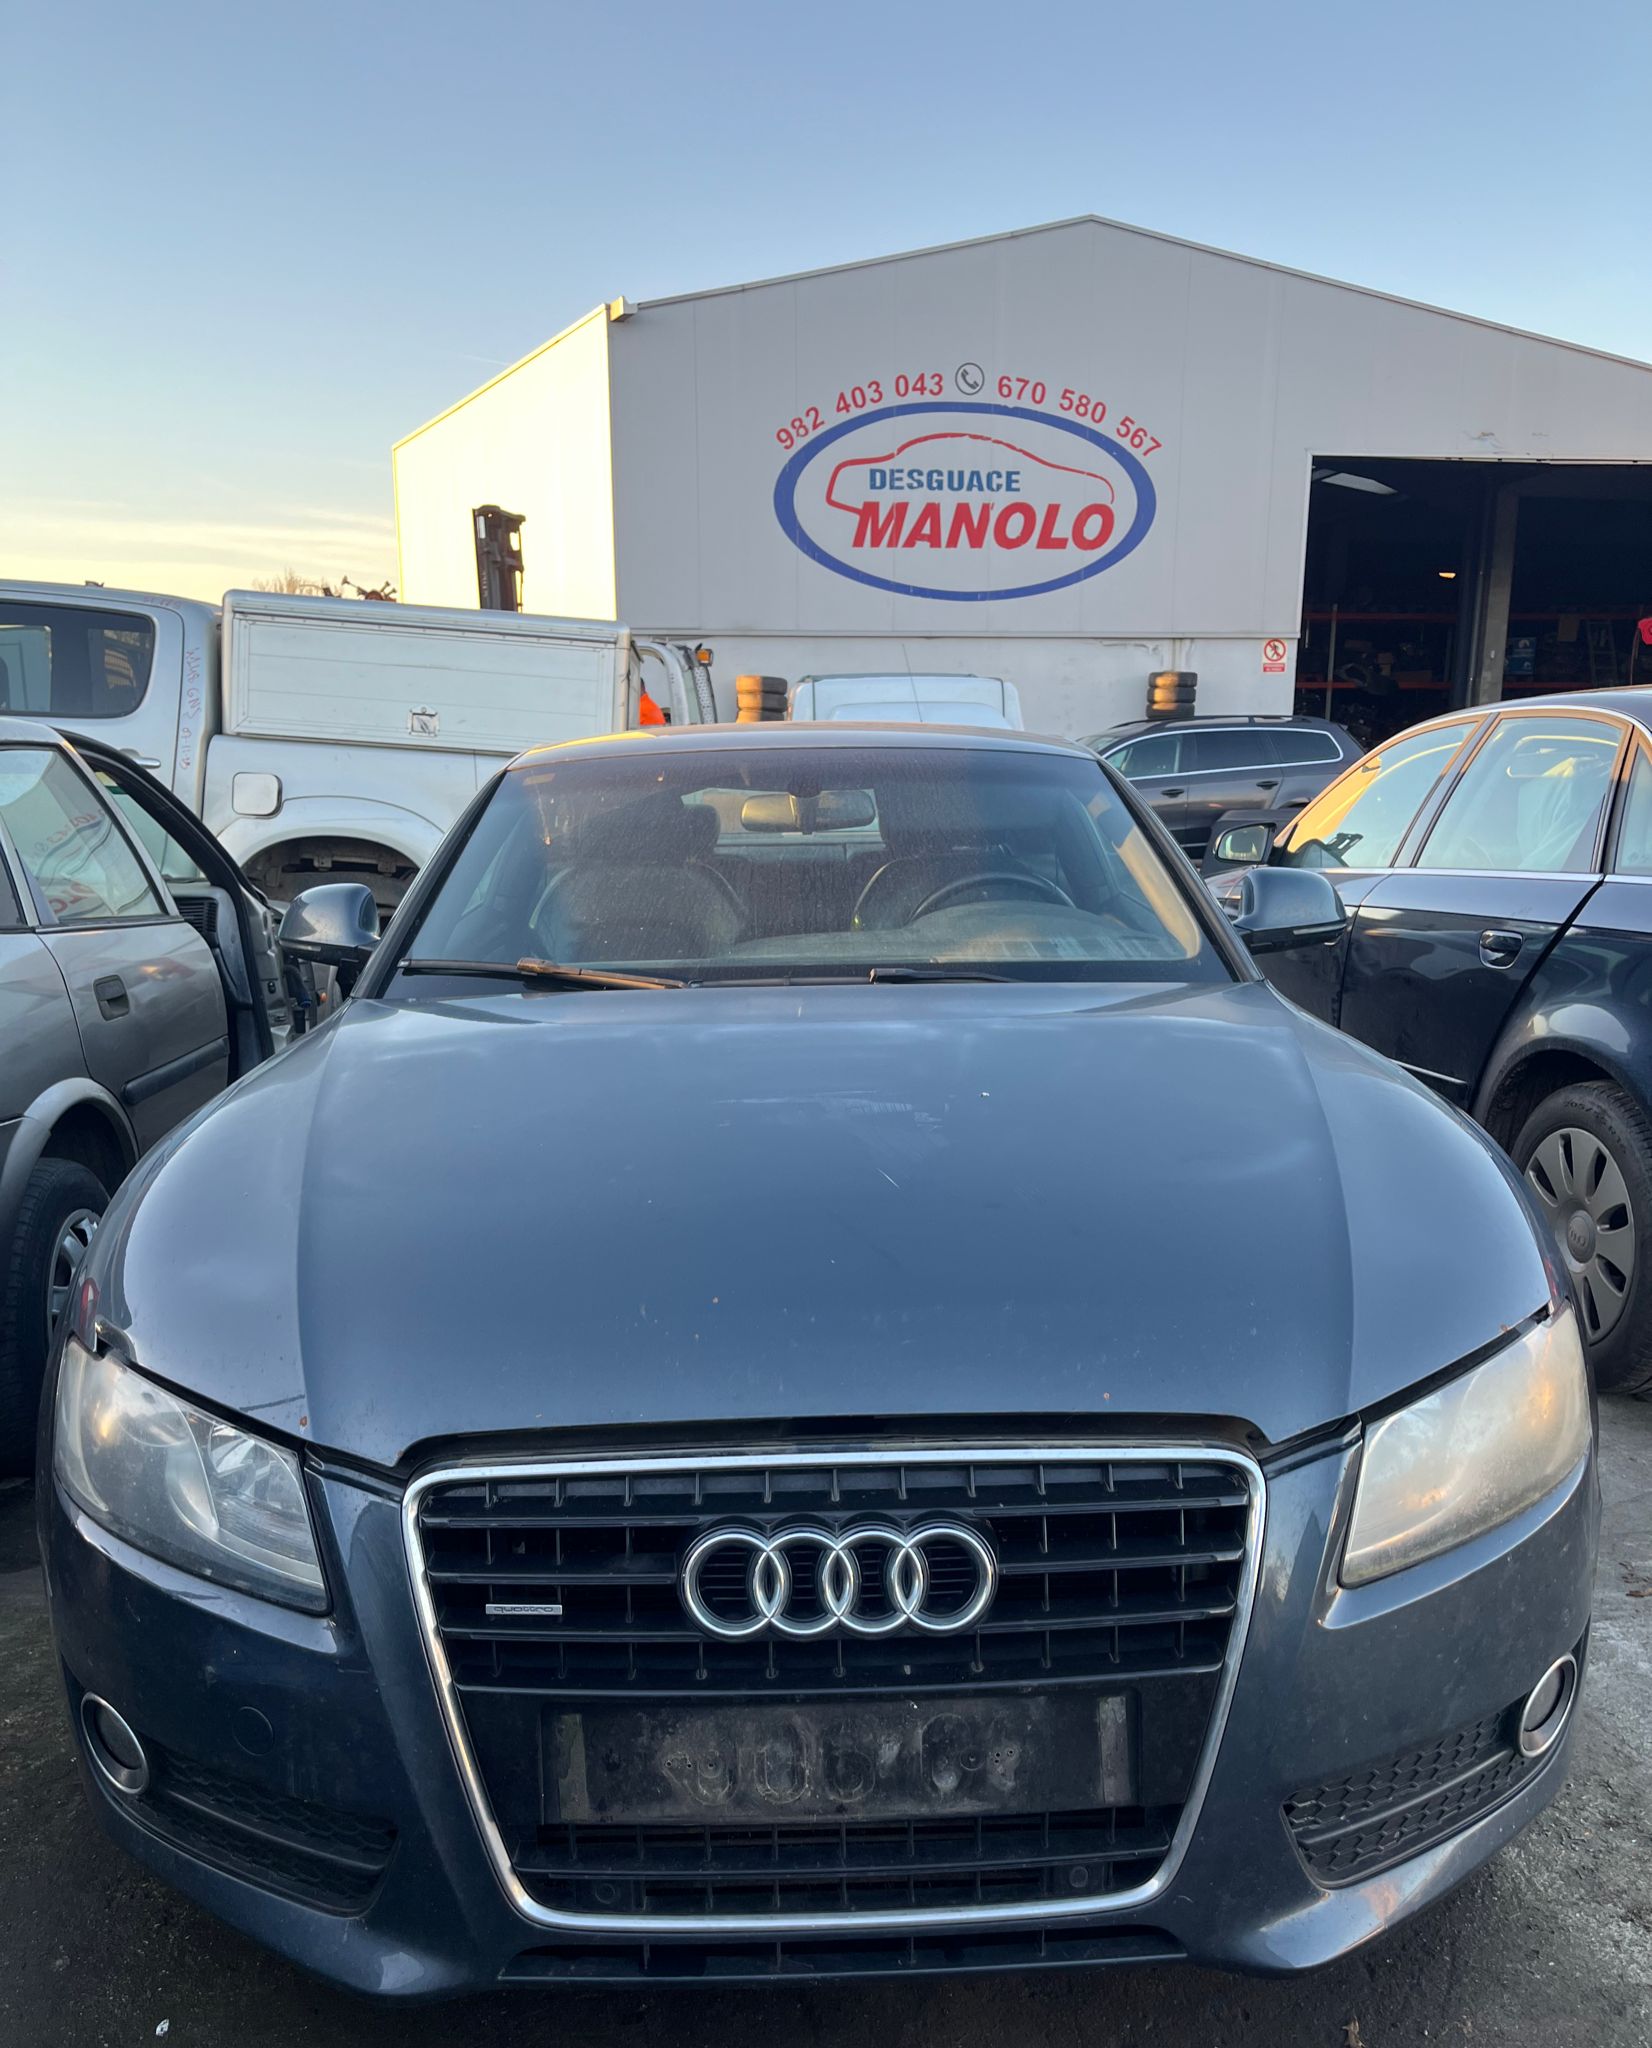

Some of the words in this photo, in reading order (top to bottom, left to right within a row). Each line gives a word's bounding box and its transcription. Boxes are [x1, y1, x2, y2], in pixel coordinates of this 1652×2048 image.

[775, 407, 824, 450] 982
[835, 380, 883, 413] 403
[895, 373, 943, 397] 043
[998, 376, 1046, 405] 670
[1059, 388, 1107, 424] 580
[1116, 416, 1162, 457] 567
[868, 467, 1021, 493] DESGUACE
[851, 501, 1115, 551] MANOLO
